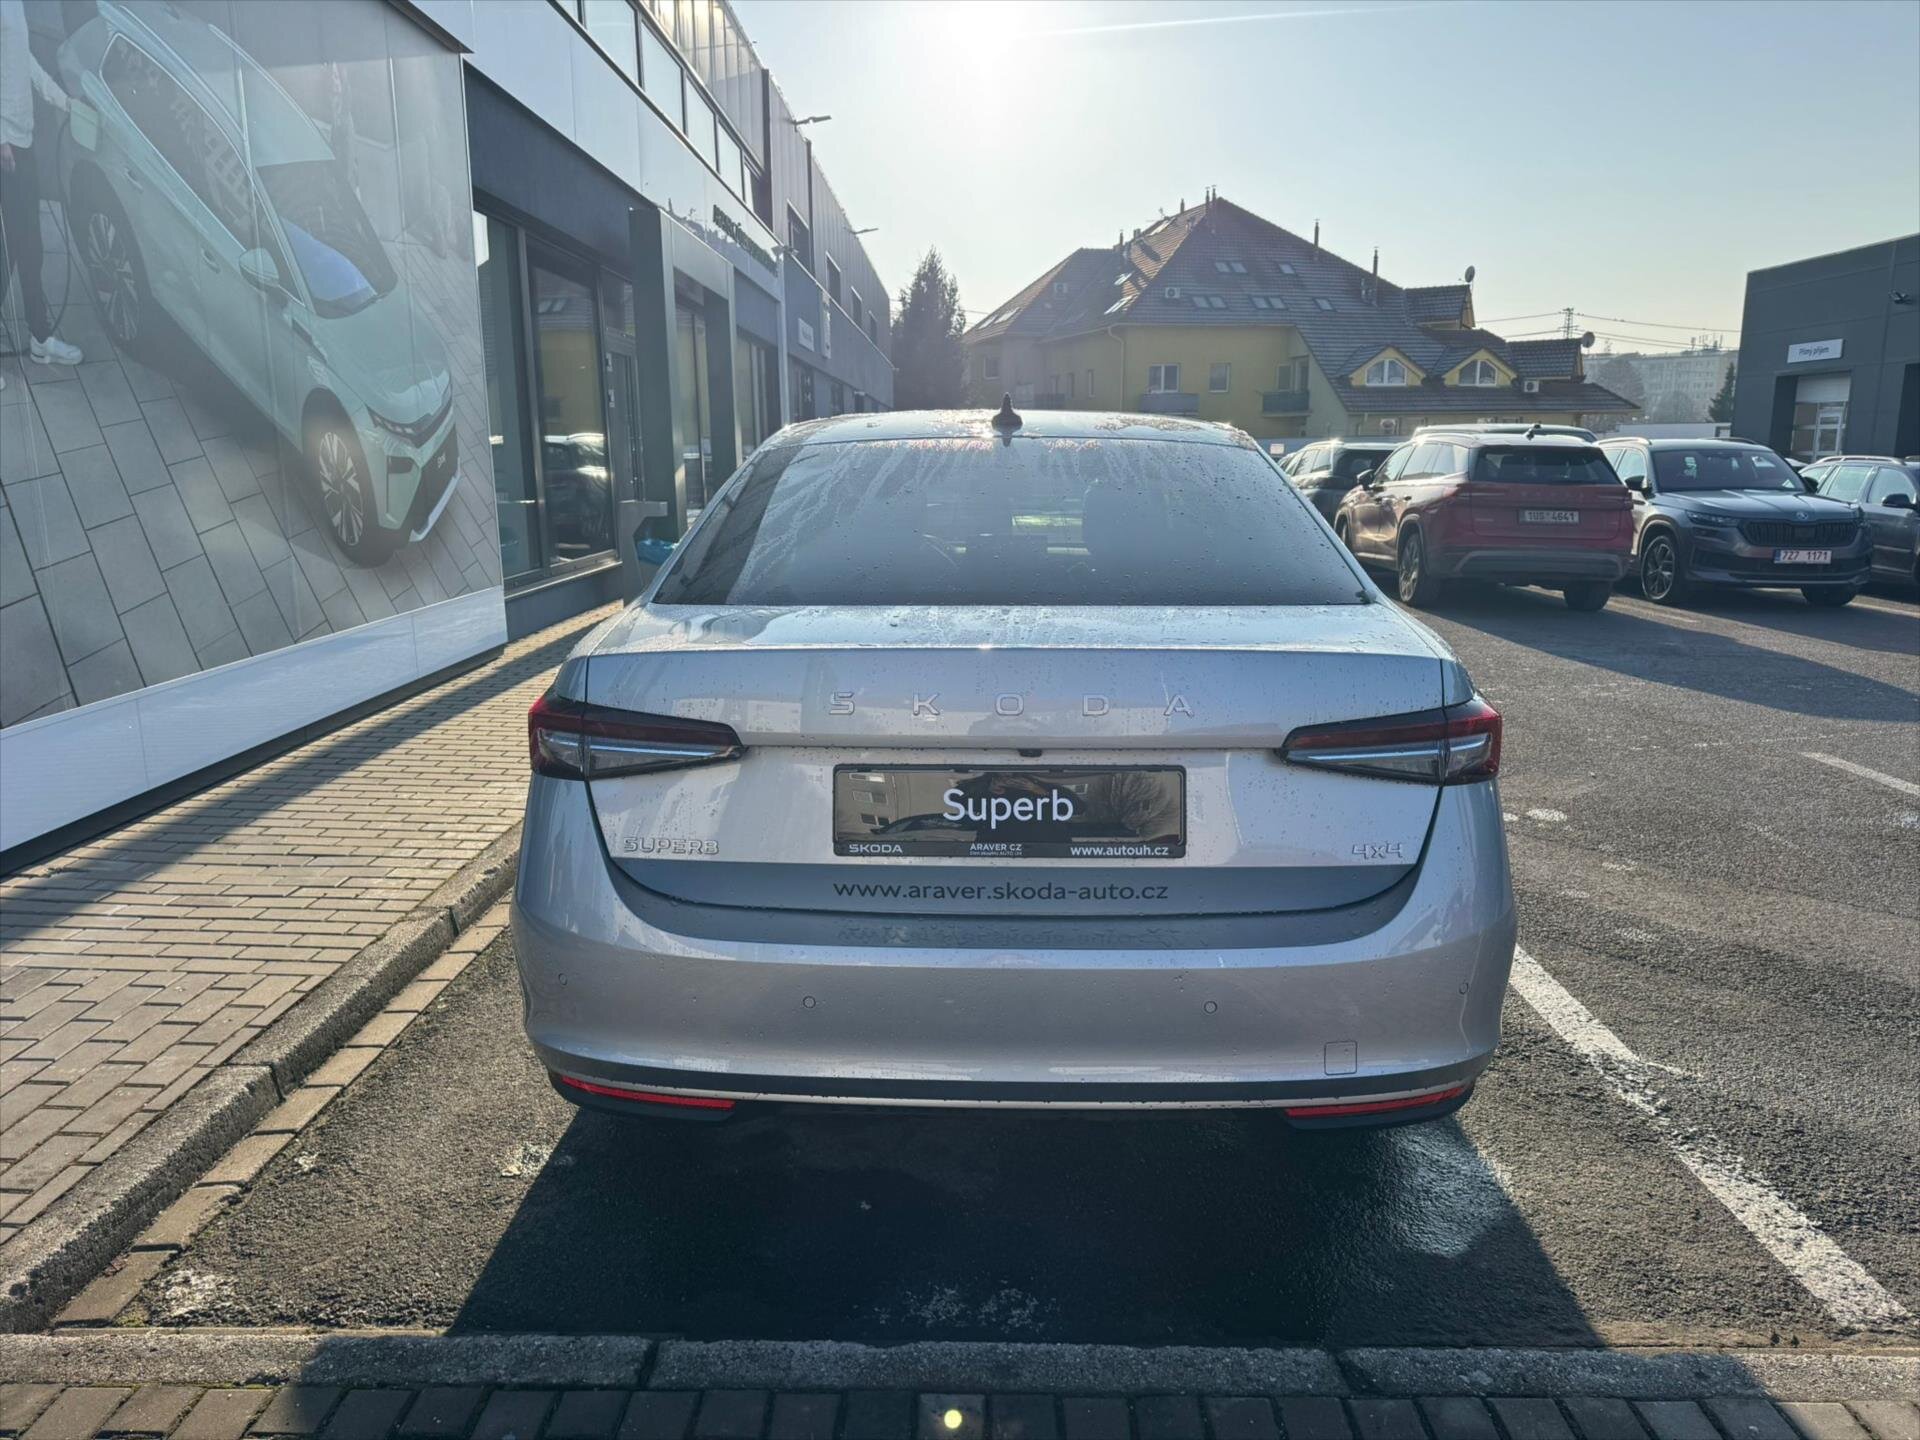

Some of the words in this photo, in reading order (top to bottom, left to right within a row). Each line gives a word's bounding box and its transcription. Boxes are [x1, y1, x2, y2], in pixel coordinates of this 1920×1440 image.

[1807, 551, 1828, 561] 1171
[943, 788, 1074, 829] Superb
[623, 837, 720, 856] SUPERB
[969, 842, 1007, 852] ARAVER
[1009, 843, 1023, 852] CZ
[1070, 844, 1169, 856] www.autouh.cz
[1352, 842, 1403, 860] 4x4
[833, 882, 1169, 901] www.araver.skoda-auto.cz
